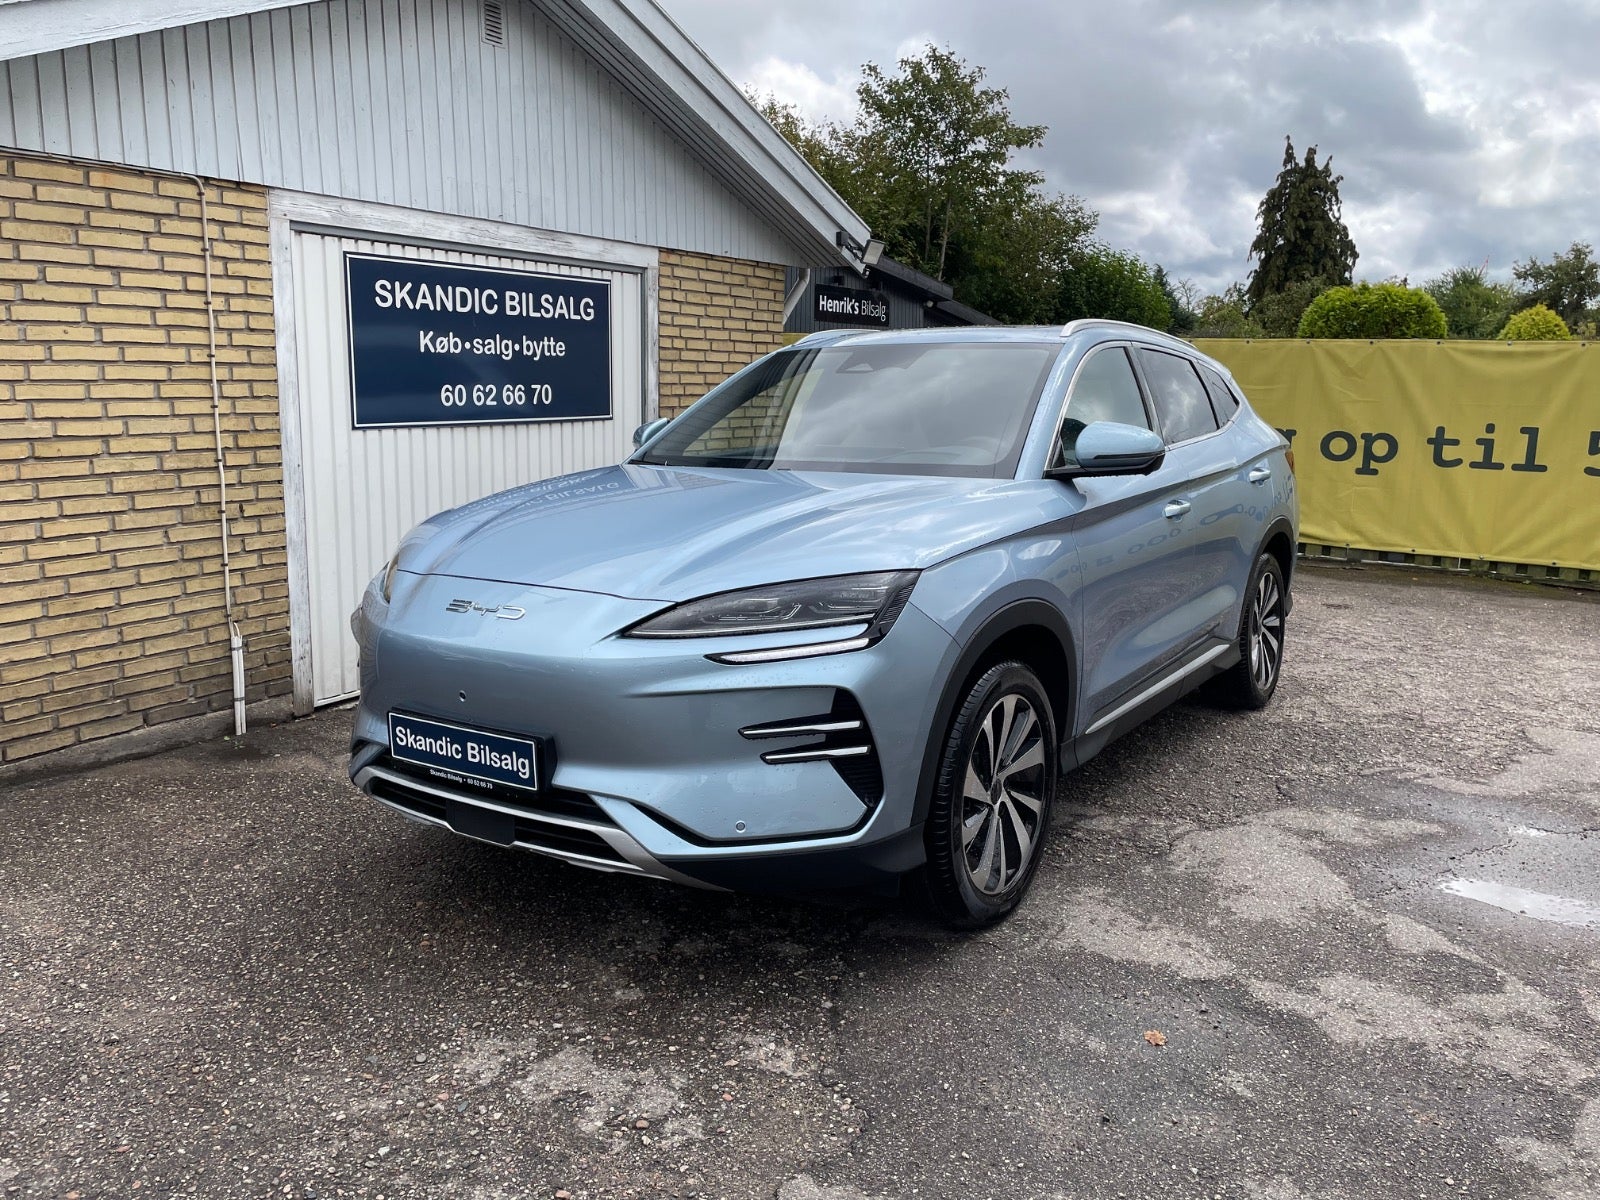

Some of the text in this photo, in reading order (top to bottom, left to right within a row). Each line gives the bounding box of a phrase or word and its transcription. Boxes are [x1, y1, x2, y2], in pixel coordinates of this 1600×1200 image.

[374, 279, 595, 321] SKANDIC BILSALG
[819, 294, 887, 322] Henrik's Bilsalg
[440, 384, 552, 407] 60 62 66 70
[1320, 430, 1399, 476] op
[1426, 422, 1548, 473] til
[445, 599, 526, 620] BYD
[395, 726, 530, 779] Skandic Bilsalg
